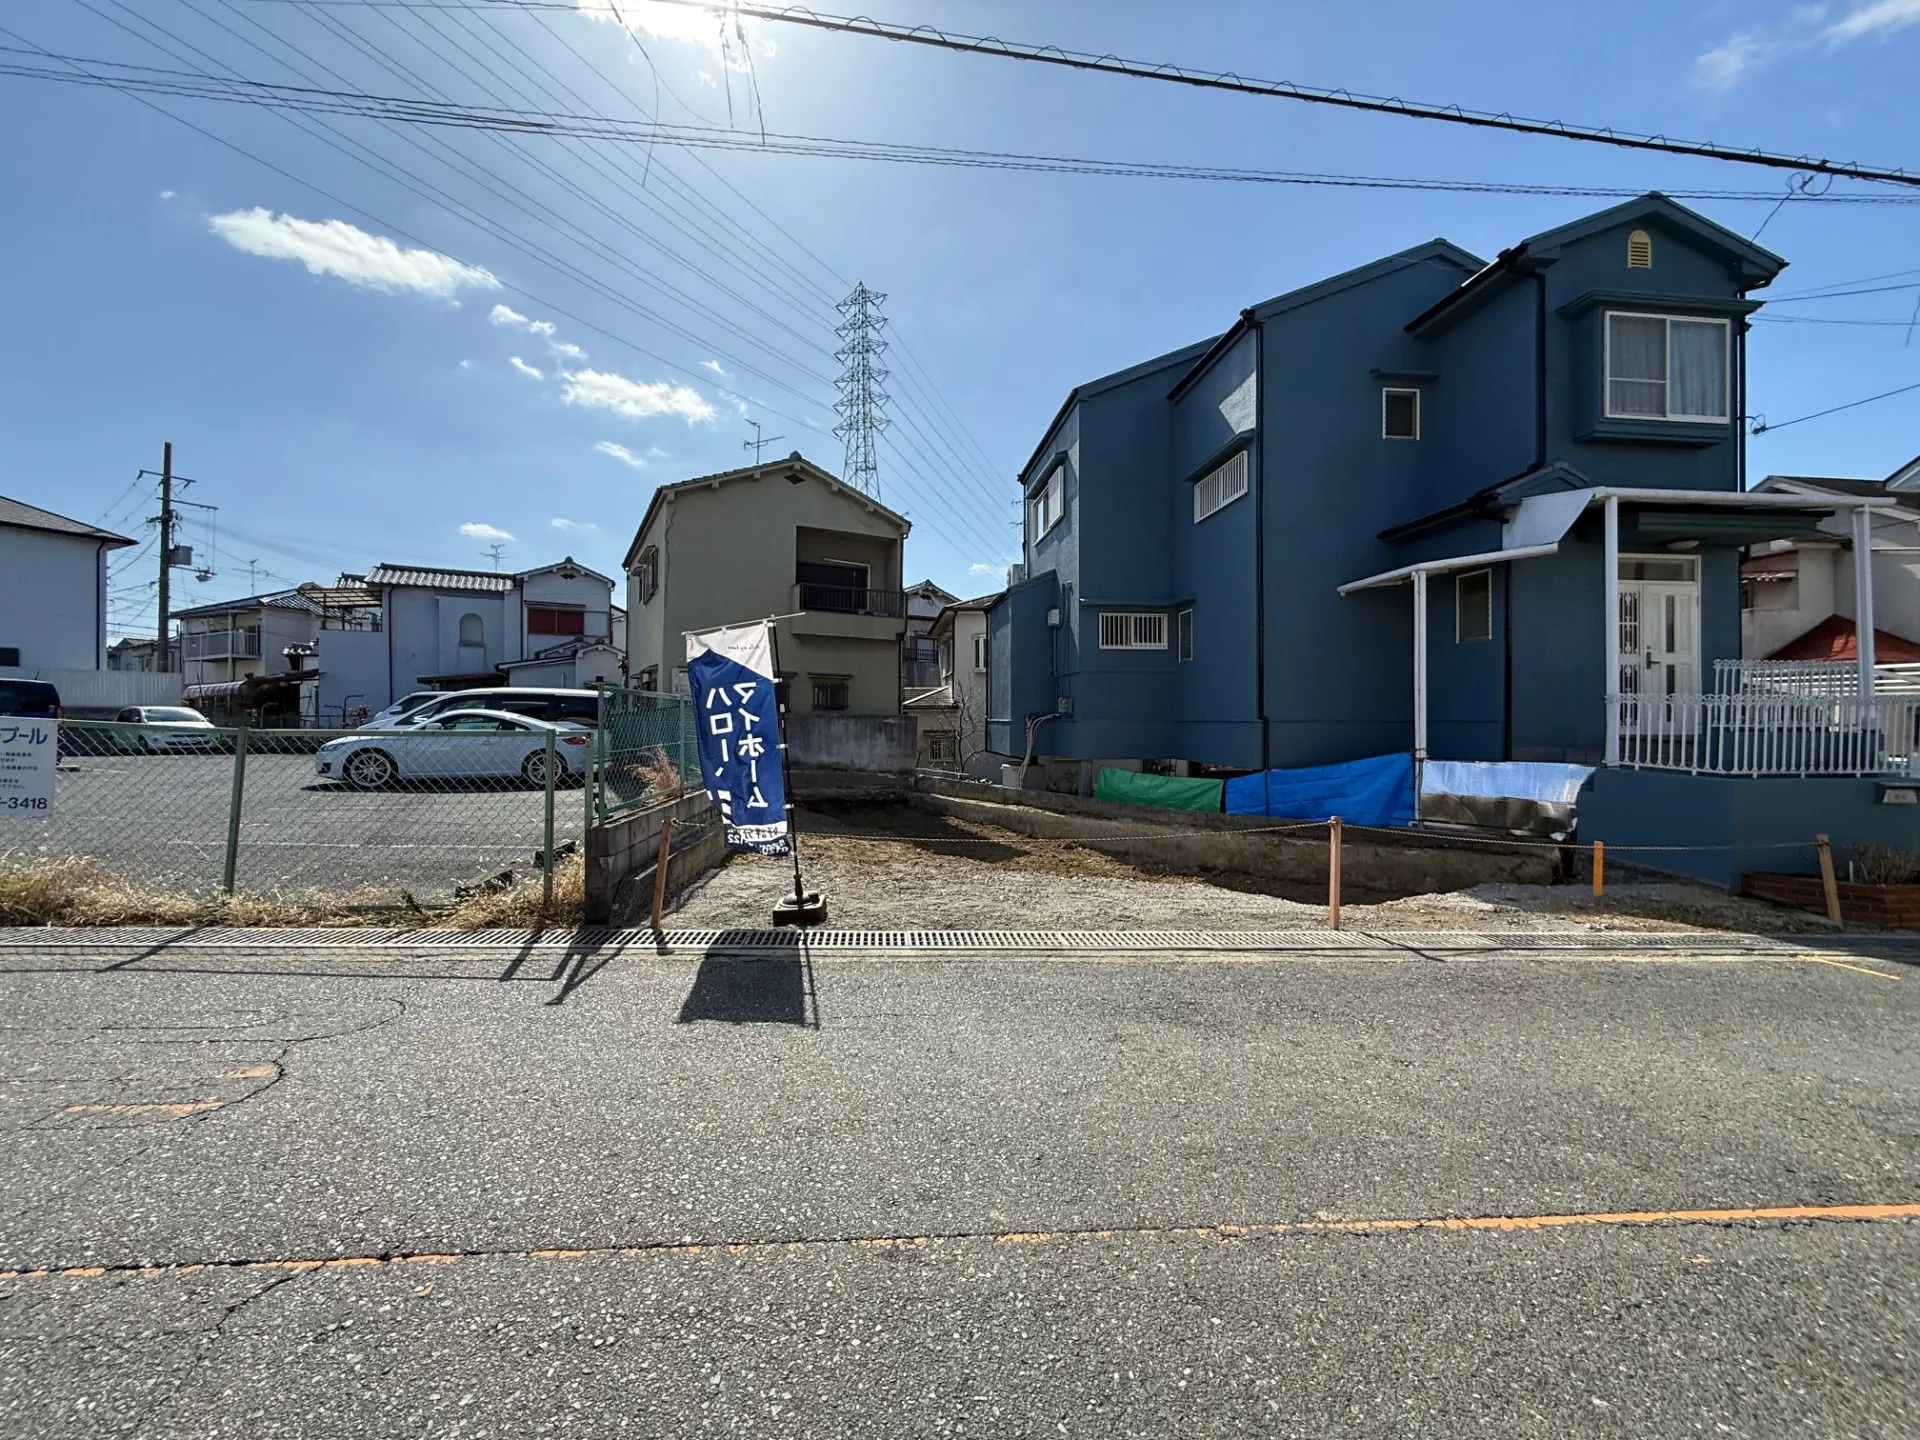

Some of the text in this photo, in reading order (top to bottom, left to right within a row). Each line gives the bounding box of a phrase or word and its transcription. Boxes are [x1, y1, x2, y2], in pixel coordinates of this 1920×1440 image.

[0, 726, 48, 745] プール
[0, 797, 48, 810] -3418
